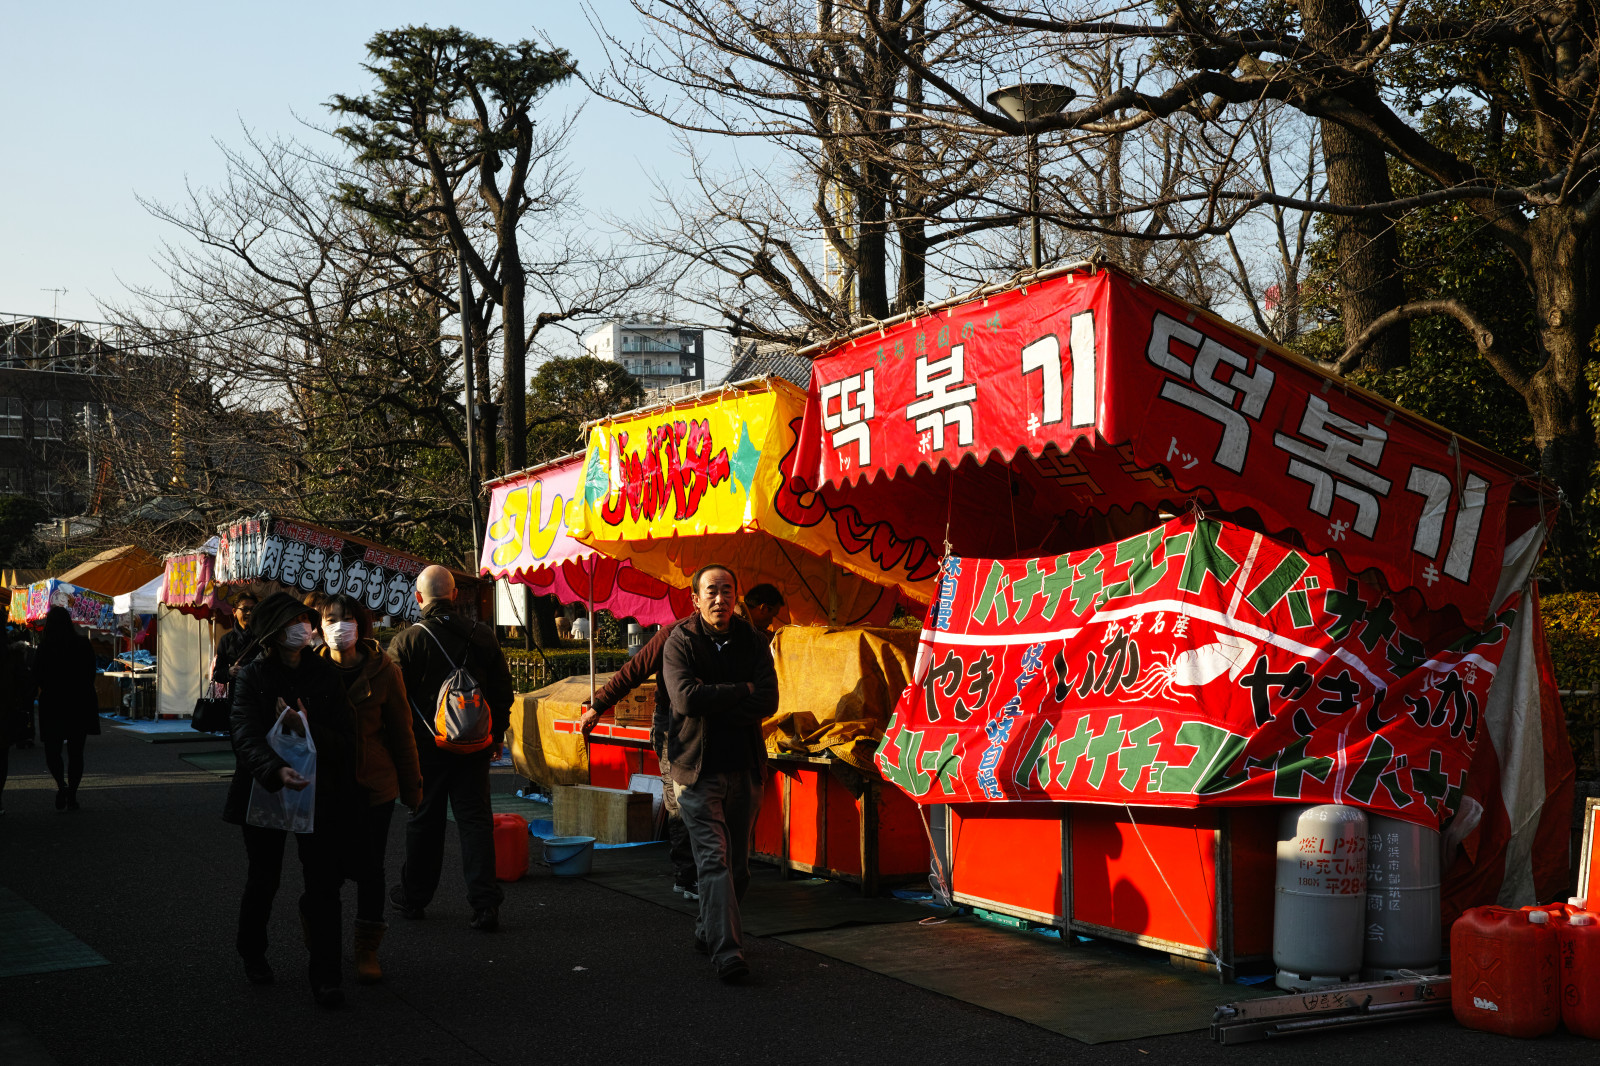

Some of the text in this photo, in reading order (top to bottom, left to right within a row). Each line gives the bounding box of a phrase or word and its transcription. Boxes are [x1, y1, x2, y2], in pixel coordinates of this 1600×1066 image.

[820, 309, 1096, 468] 떡볶기
[975, 716, 1015, 800] 味自慢
